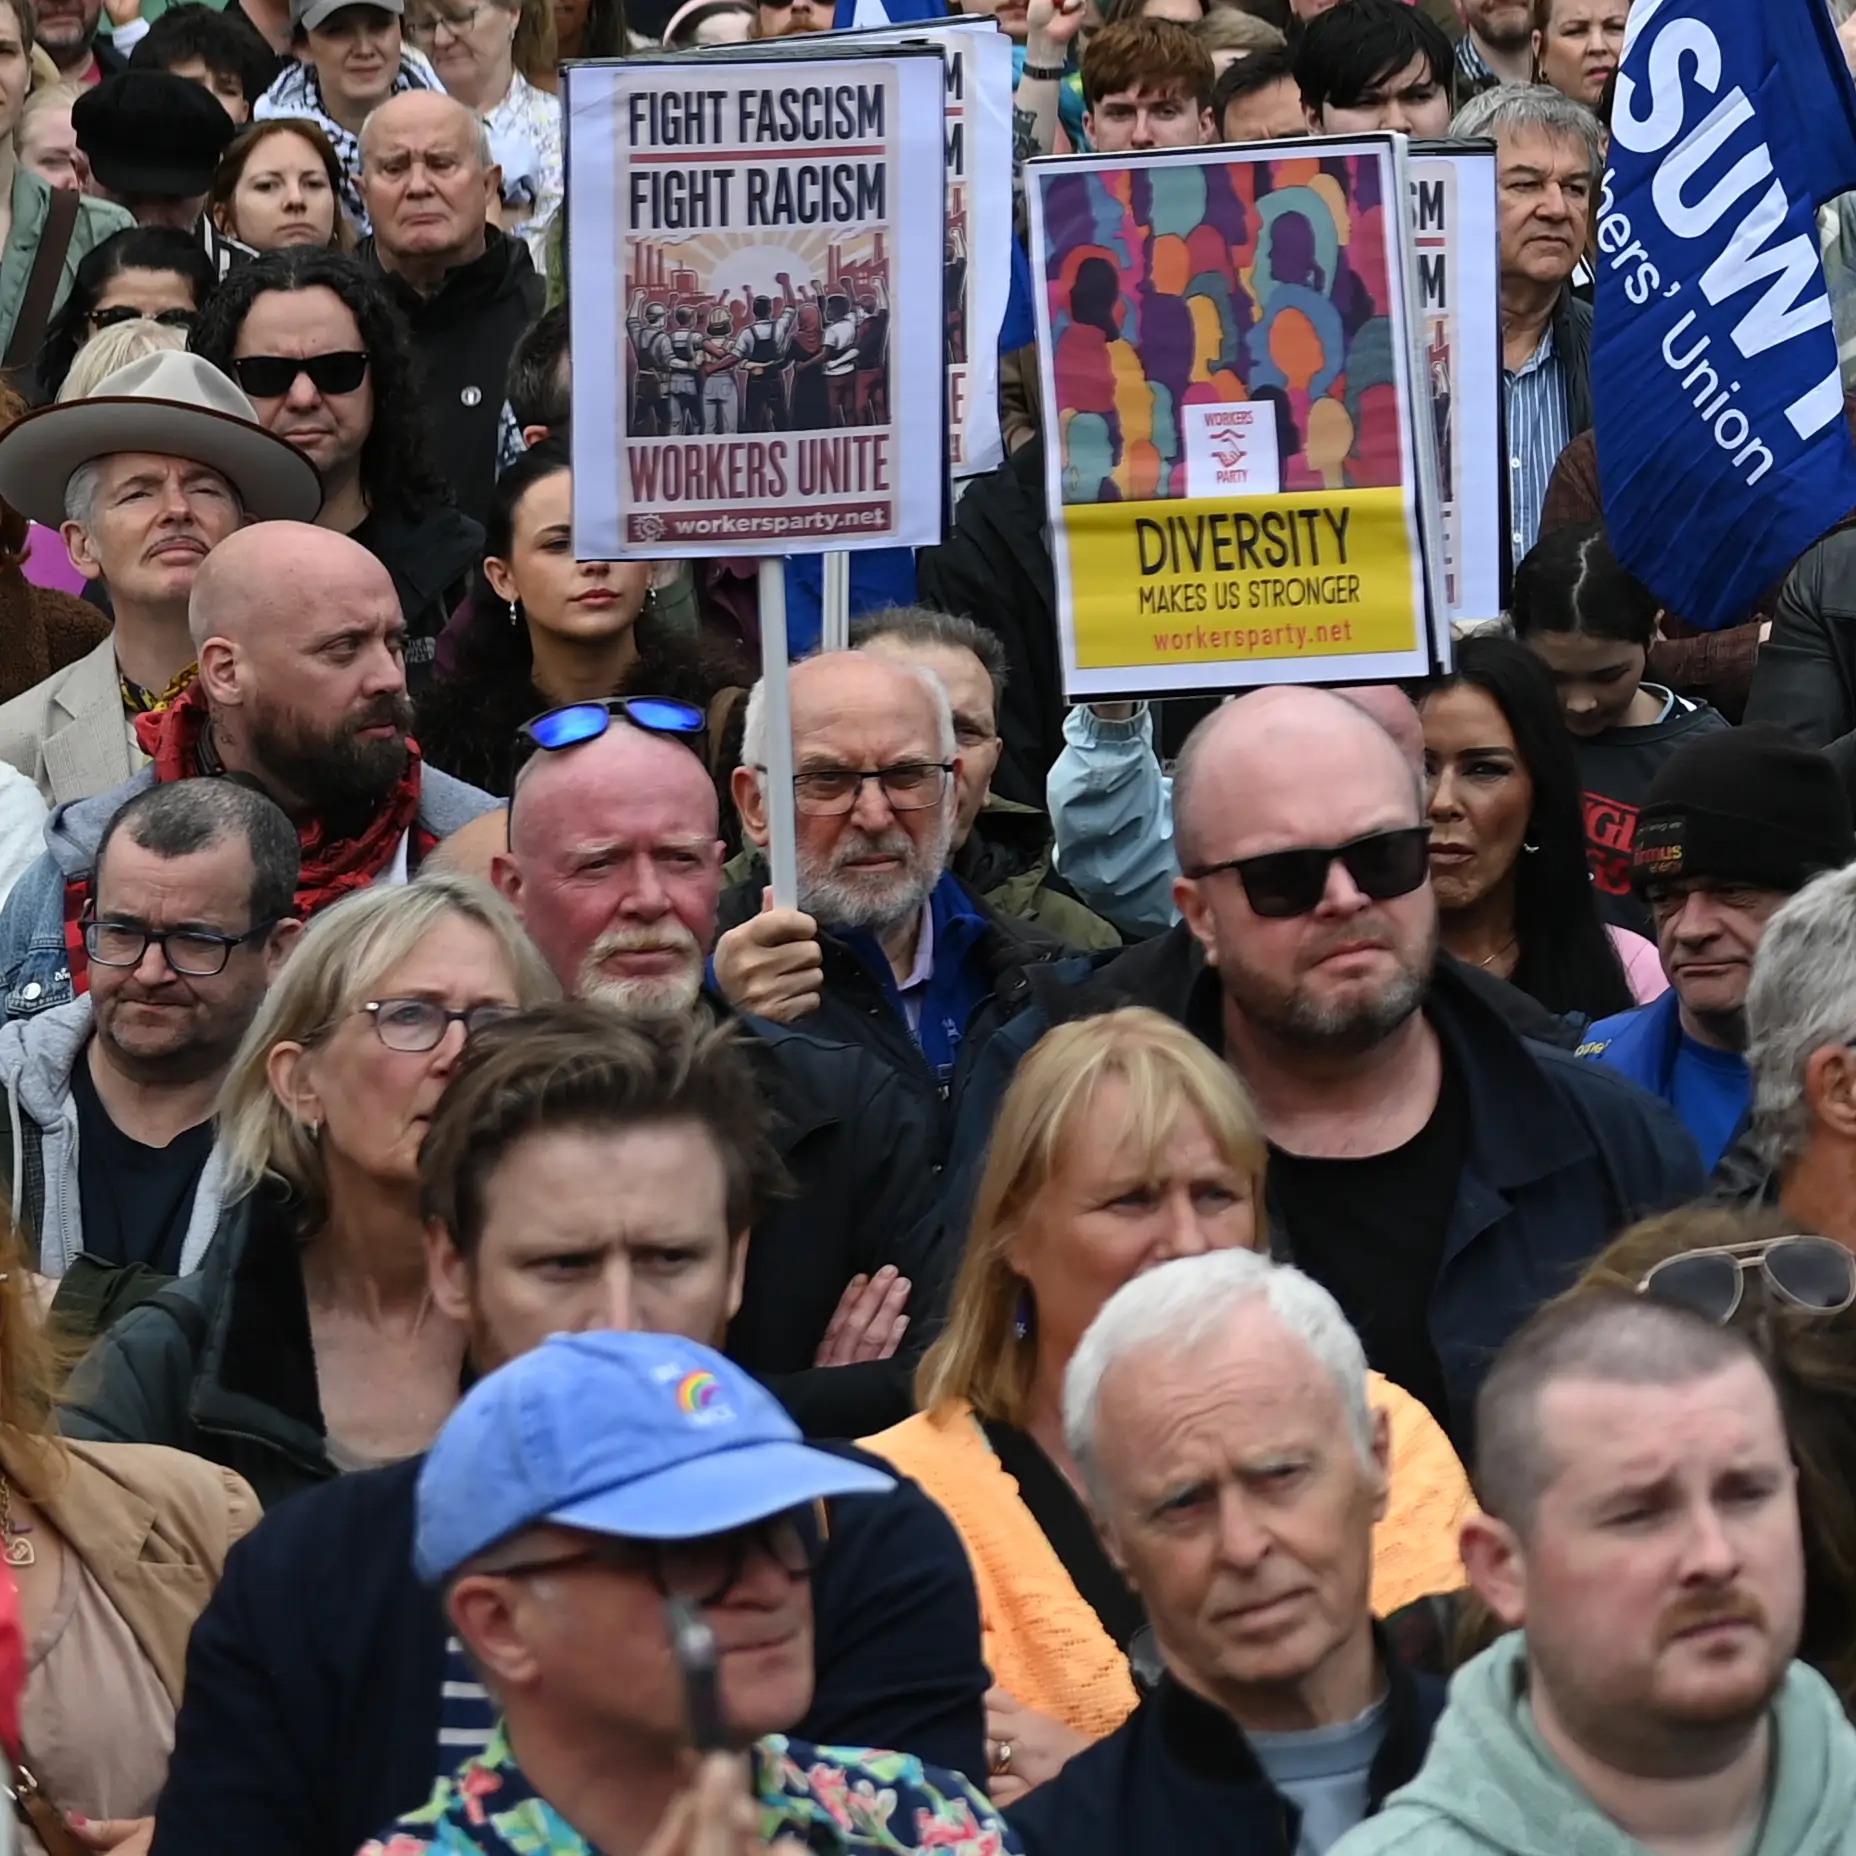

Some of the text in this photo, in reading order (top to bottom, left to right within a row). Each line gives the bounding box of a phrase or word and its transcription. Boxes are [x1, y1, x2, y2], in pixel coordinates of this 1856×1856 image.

[628, 90, 729, 147] FIGHT
[738, 82, 887, 145] FASCISM
[628, 161, 887, 231] FIGHT RACISM
[1204, 409, 1255, 428] WORKERS
[1660, 309, 1775, 489] Union
[626, 432, 891, 505] WORKERS UNITE
[1215, 468, 1248, 485] PARTY
[674, 506, 888, 538] workersparty.net
[1134, 506, 1352, 577] DIVERSITY
[1138, 573, 1361, 616] MAKES US STRONGER
[1152, 618, 1353, 653] workersparty.net
